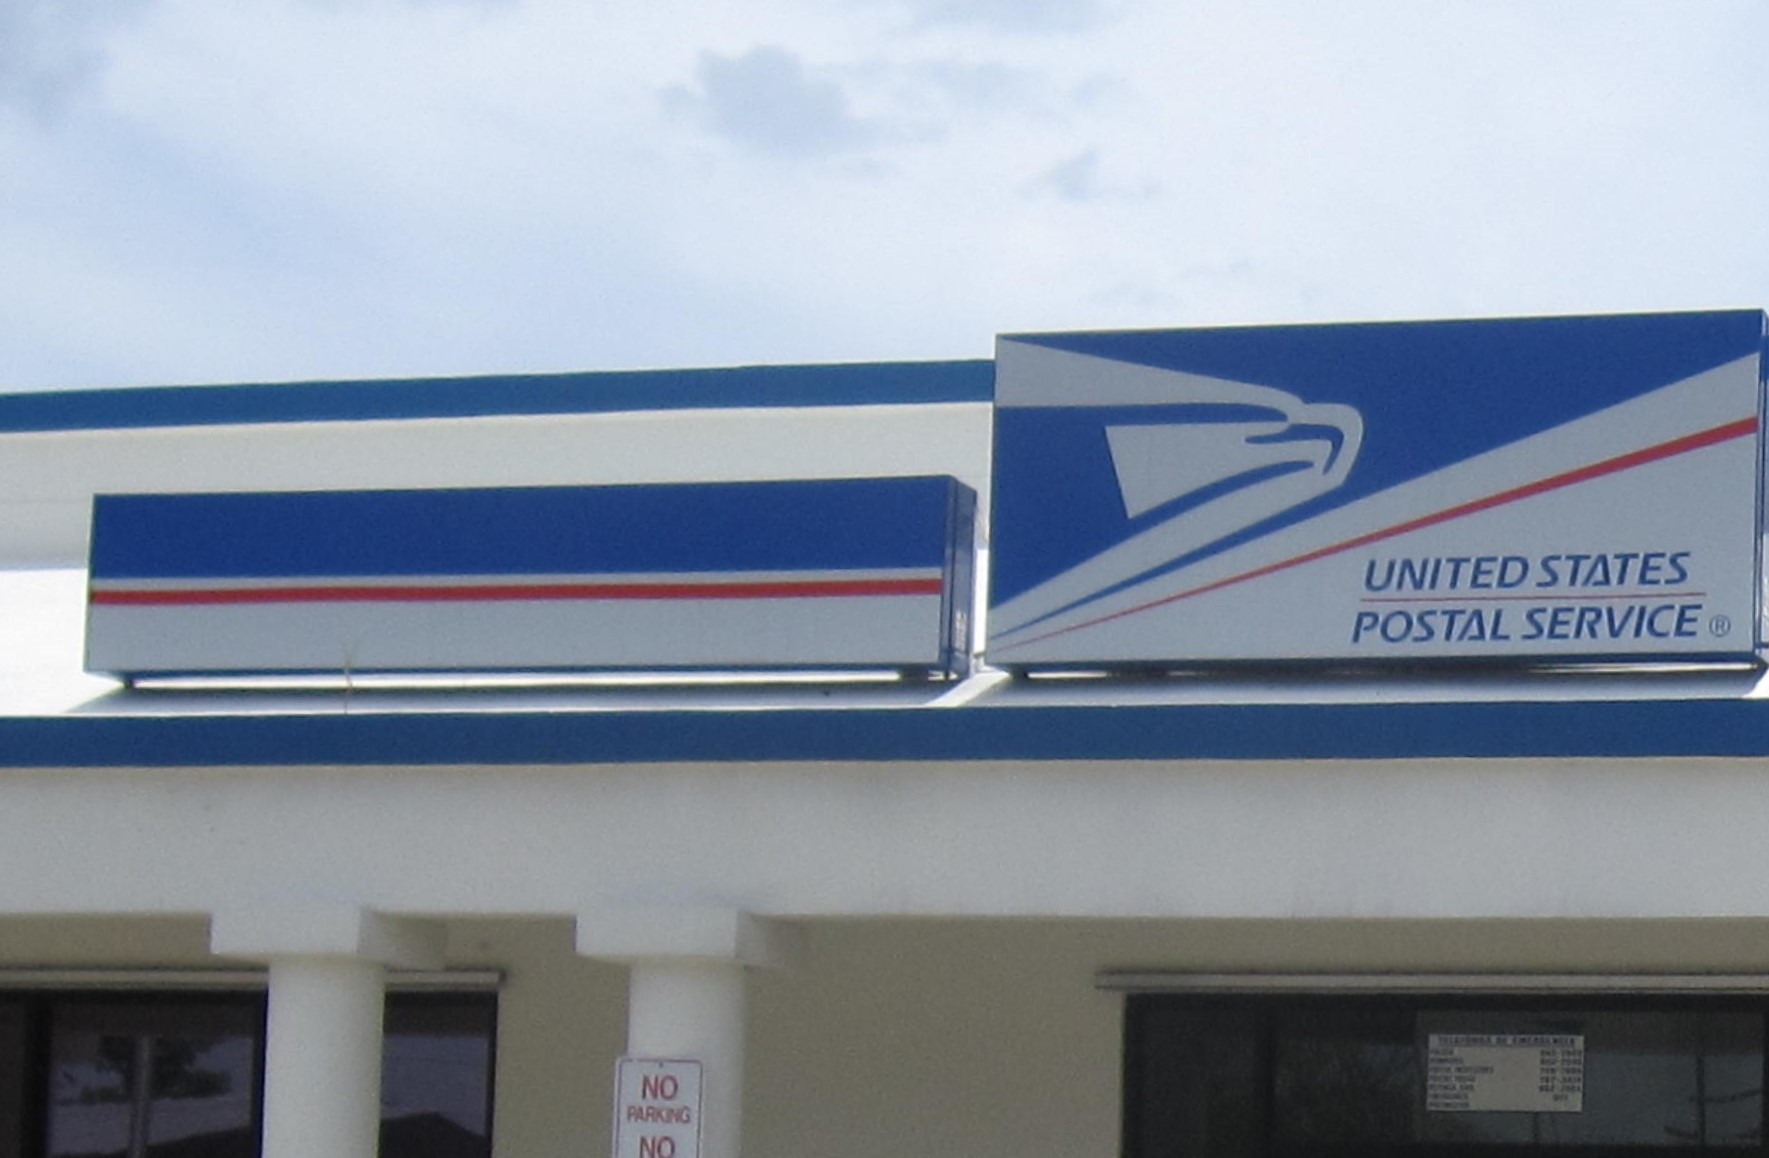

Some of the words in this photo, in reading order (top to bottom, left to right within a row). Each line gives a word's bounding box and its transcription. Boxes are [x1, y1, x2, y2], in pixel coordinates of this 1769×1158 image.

[1364, 555, 1529, 592] UNITED
[1536, 551, 1692, 587] STATES
[1352, 608, 1511, 644] POSTAL
[1521, 603, 1703, 641] SERVICE
[641, 1074, 678, 1100] NO
[627, 1105, 691, 1124] PARKING
